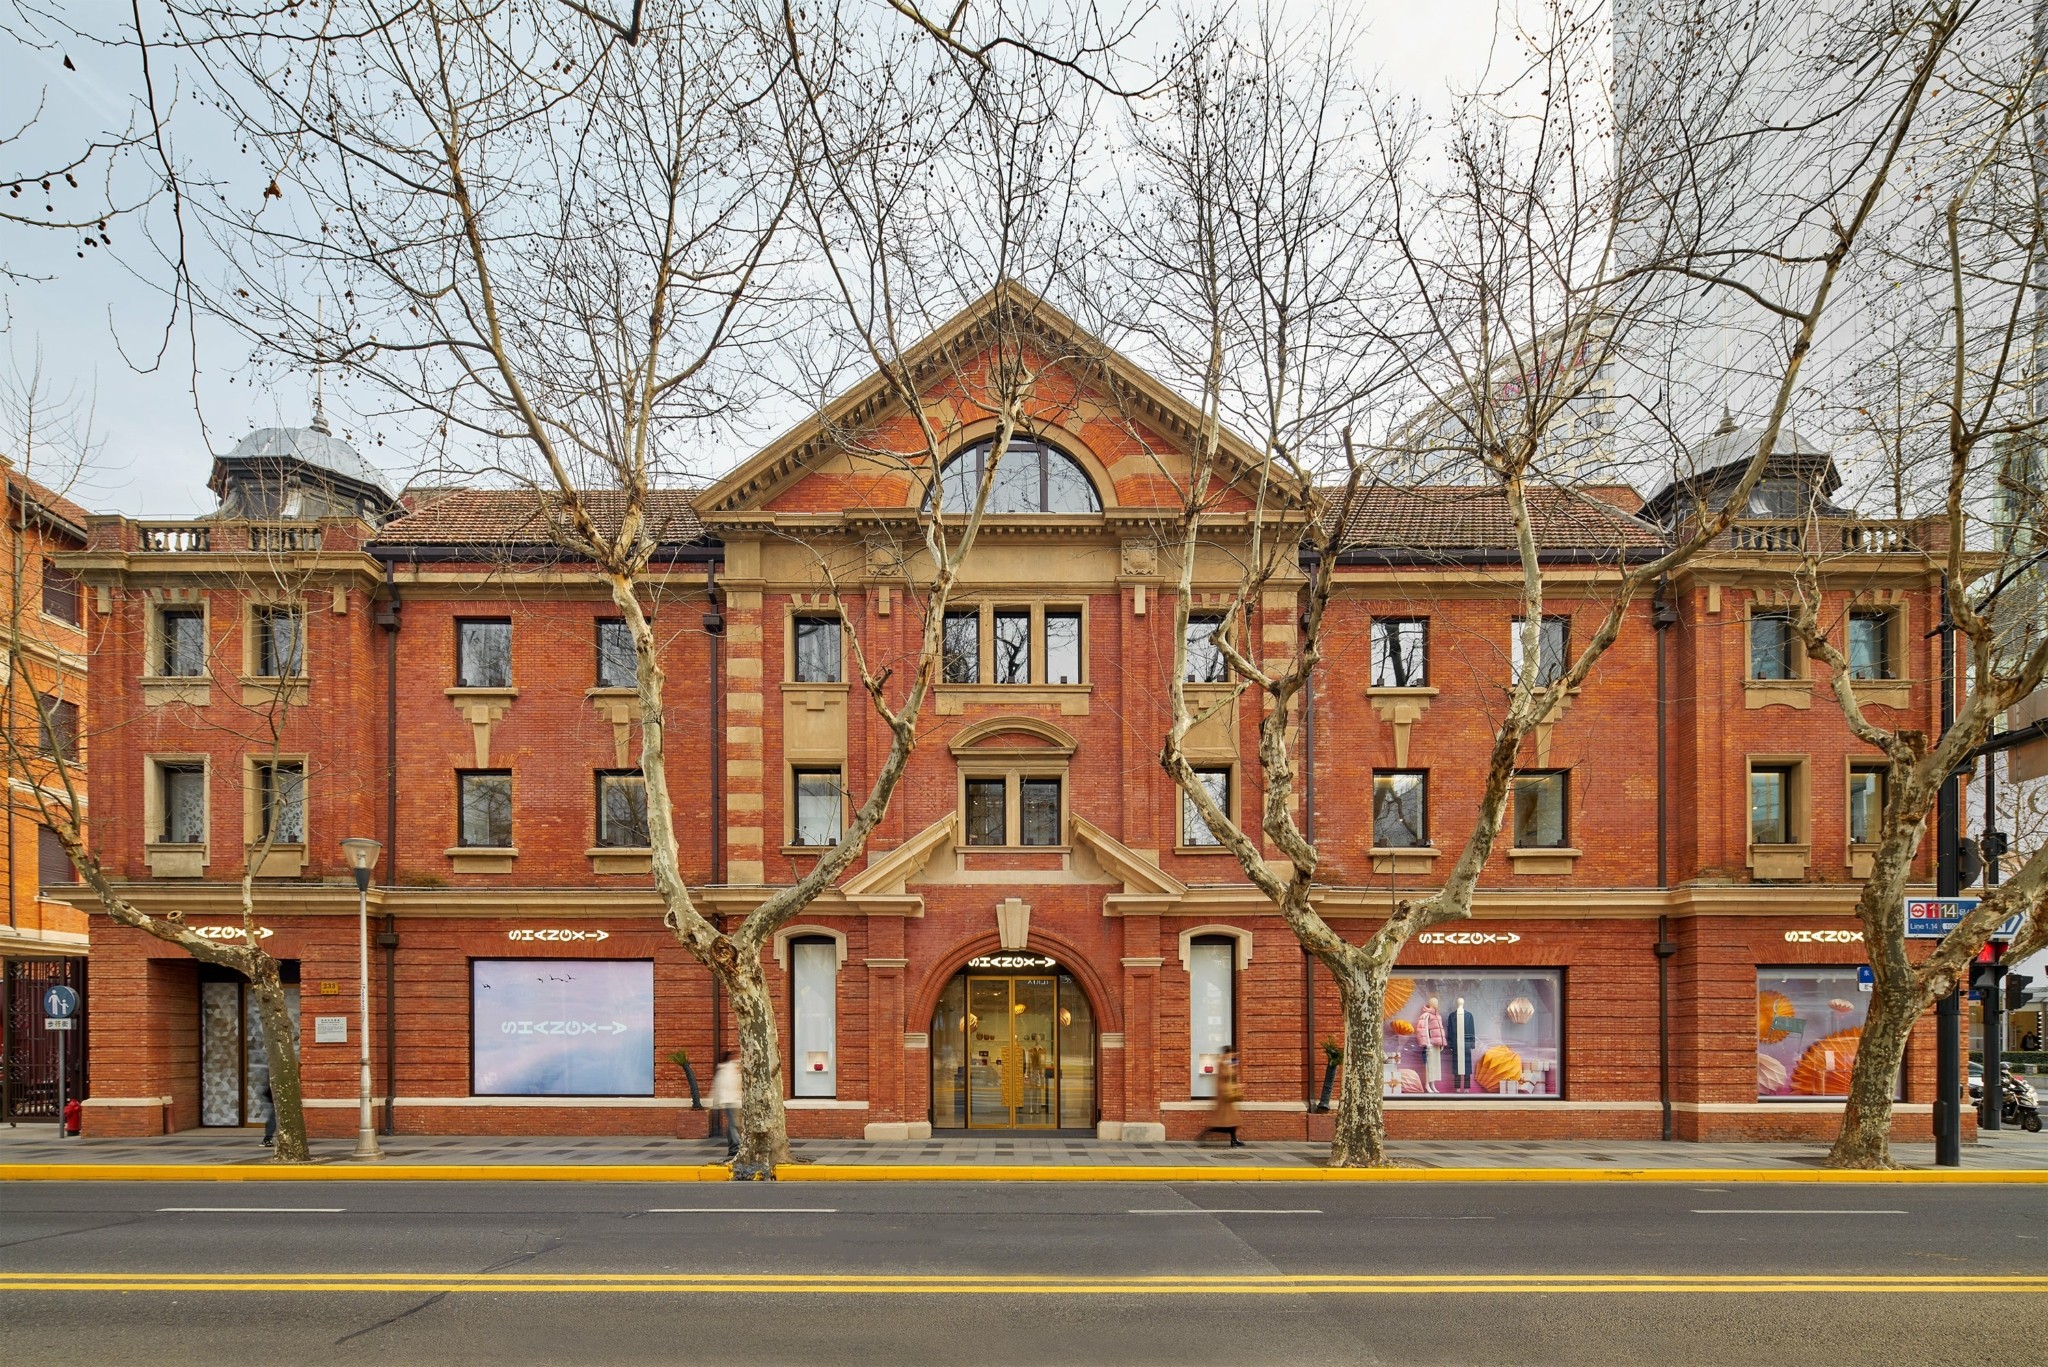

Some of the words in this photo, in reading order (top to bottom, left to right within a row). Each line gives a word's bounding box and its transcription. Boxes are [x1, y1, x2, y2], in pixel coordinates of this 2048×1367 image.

[1941, 904, 1957, 918] 14
[187, 926, 274, 939] ANGXIA
[508, 929, 610, 942] SHANGXIA
[1418, 932, 1521, 945] SHANGXIA
[1784, 930, 1865, 943] SHANGX
[968, 956, 1056, 968] SHANGXIA
[47, 1020, 69, 1028] 步行街
[501, 1020, 628, 1036] SHANGXIA
